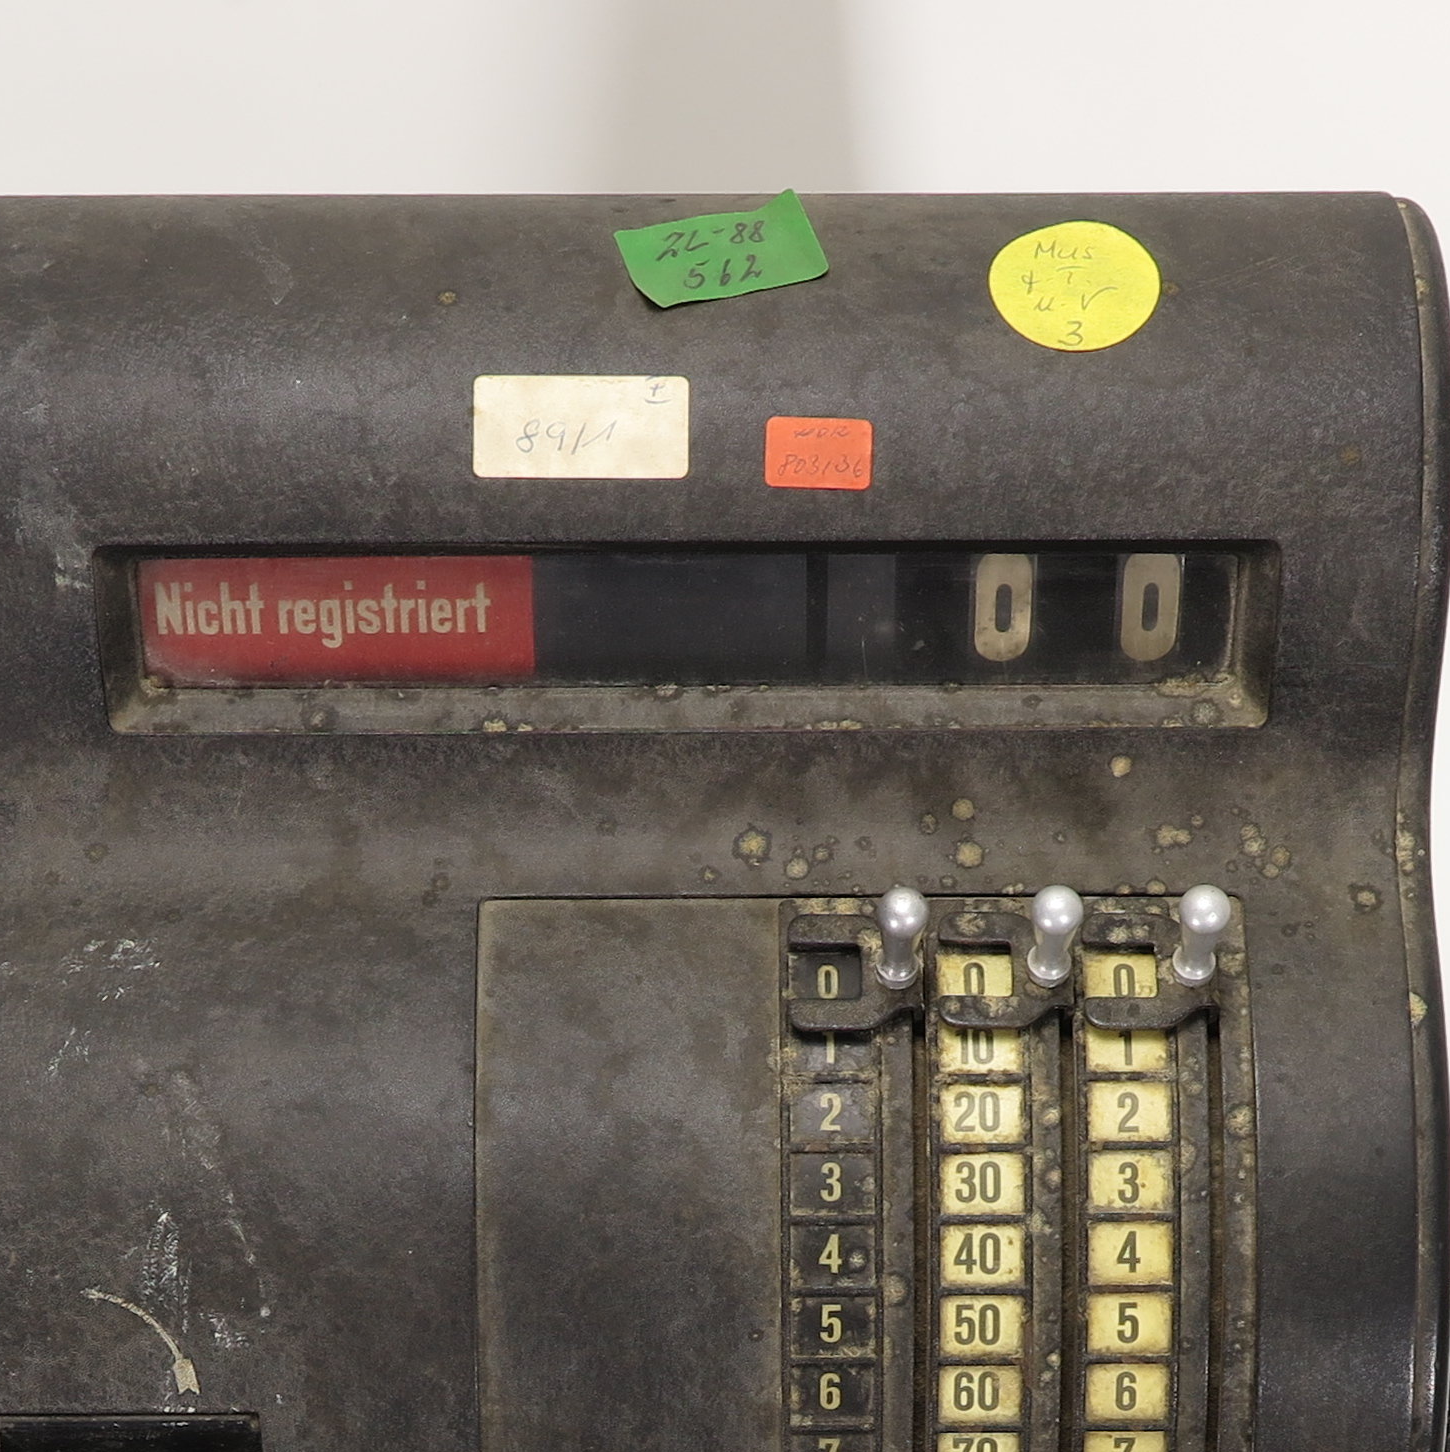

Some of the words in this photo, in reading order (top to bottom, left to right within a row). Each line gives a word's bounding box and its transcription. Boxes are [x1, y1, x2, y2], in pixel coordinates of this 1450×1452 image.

[683, 253, 763, 289] 562
[1057, 320, 1084, 346] 3
[154, 581, 265, 636] Nicht
[278, 580, 492, 649] registriert
[974, 552, 1034, 662] 0
[1120, 552, 1181, 662] 0
[817, 964, 840, 999] 0
[963, 962, 986, 996] 0
[1112, 963, 1136, 998] 0
[823, 1031, 836, 1064] 1
[955, 1029, 995, 1065] 10
[1119, 1031, 1133, 1066] 1
[820, 1092, 841, 1132] 2
[953, 1092, 1000, 1133] 20
[1117, 1092, 1140, 1133] 2
[820, 1163, 842, 1202] 3
[955, 1162, 1002, 1203] 30
[1117, 1162, 1140, 1203] 3
[818, 1233, 842, 1274] 4
[953, 1232, 1001, 1275] 40
[1116, 1231, 1141, 1274] 4
[820, 1304, 843, 1344] 5
[953, 1303, 1001, 1346] 50
[1116, 1302, 1139, 1344] 5
[819, 1372, 841, 1411] 6
[952, 1371, 999, 1411] 60
[1114, 1371, 1138, 1411] 6
